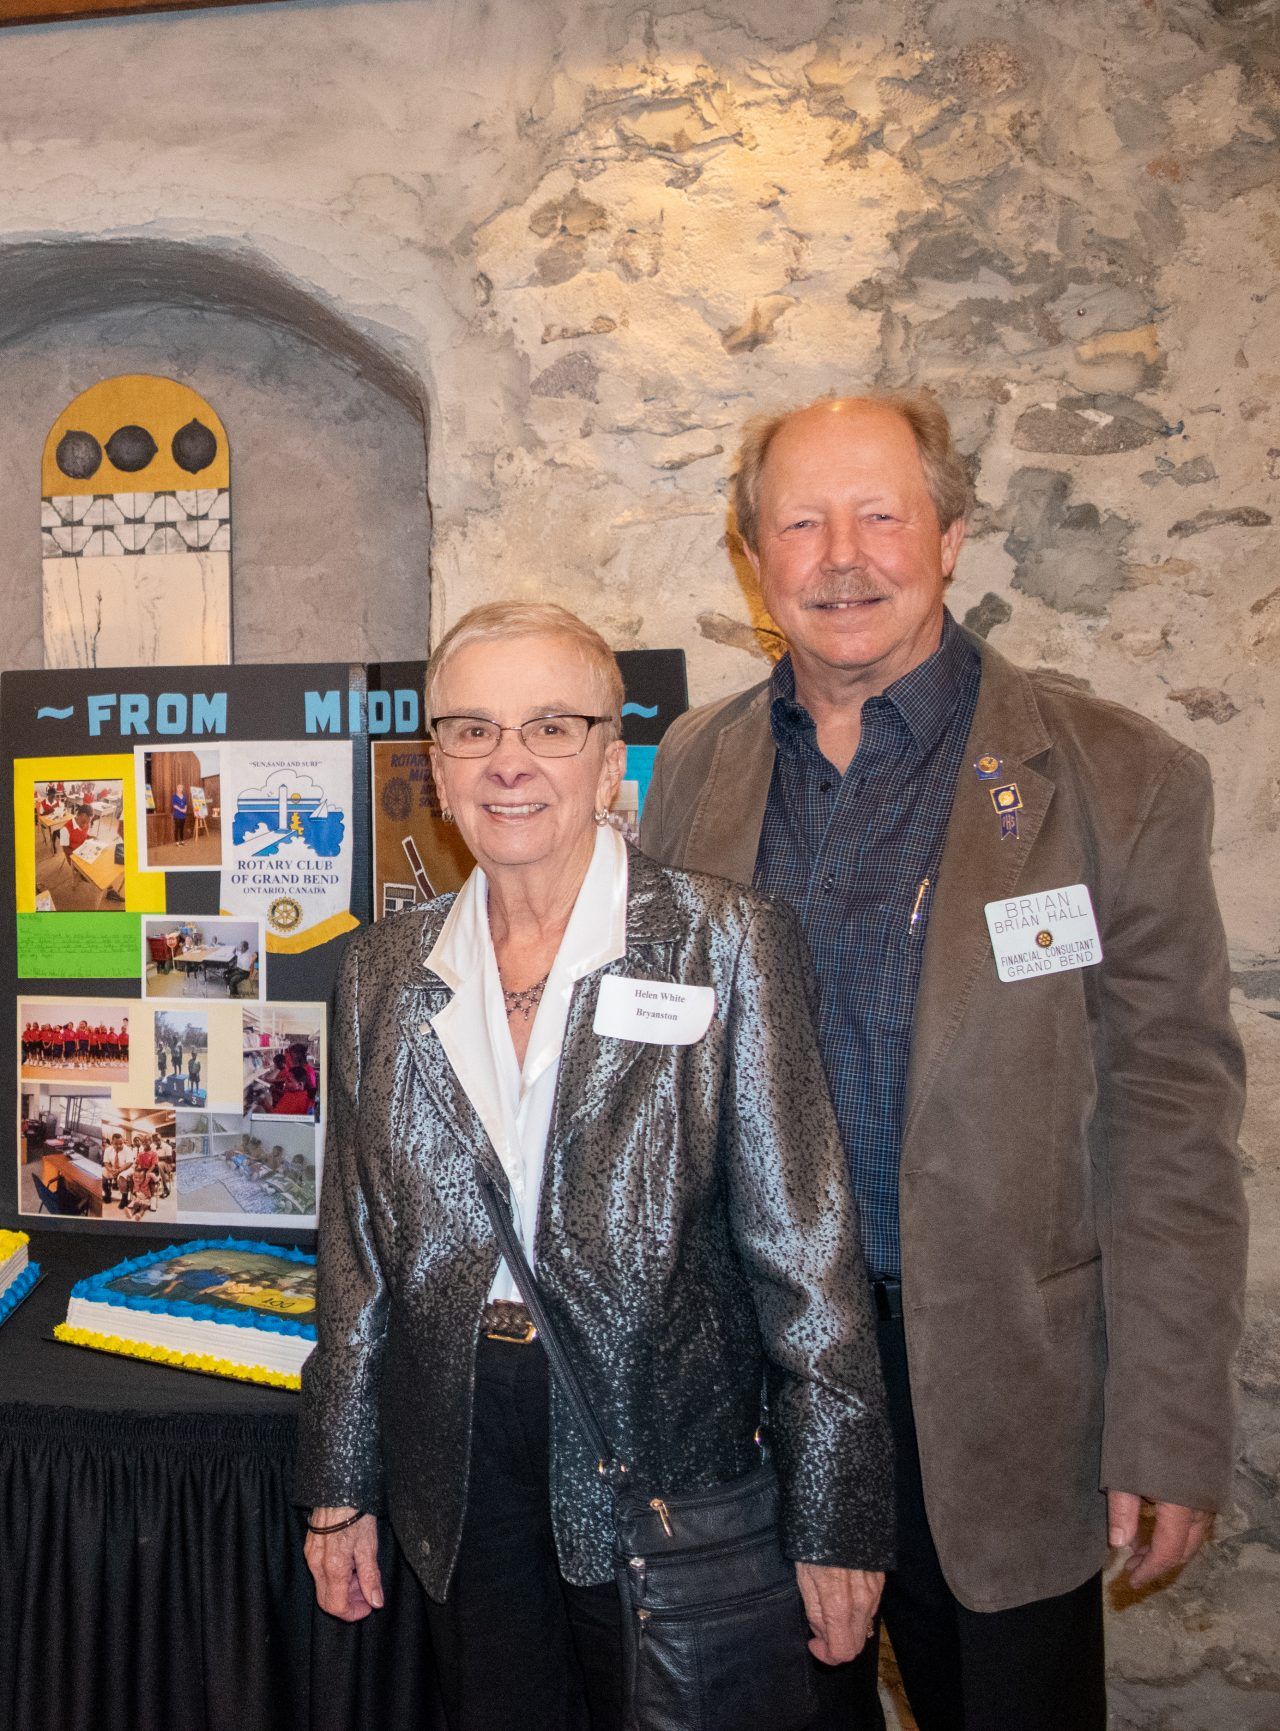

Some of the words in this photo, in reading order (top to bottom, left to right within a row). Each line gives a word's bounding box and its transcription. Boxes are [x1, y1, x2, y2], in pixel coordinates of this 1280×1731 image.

[87, 692, 228, 737] FROM
[237, 860, 294, 871] ROTARY
[297, 860, 333, 871] CLUB
[231, 874, 248, 884] OF
[252, 874, 299, 884] GRAND
[303, 874, 339, 884] BEND
[243, 887, 287, 895] ONTARIO,
[1004, 891, 1070, 919] BRIAN
[994, 914, 1040, 934] BRIAN
[1046, 905, 1088, 923] HALL
[1001, 950, 1043, 967] FINANCIAL
[1045, 938, 1094, 957] CONSULTANT
[1007, 959, 1052, 978] GRAND
[1059, 951, 1093, 967] BEND
[634, 989, 658, 1000] Helen
[660, 991, 686, 1003] White
[636, 1008, 678, 1021] Bryanston
